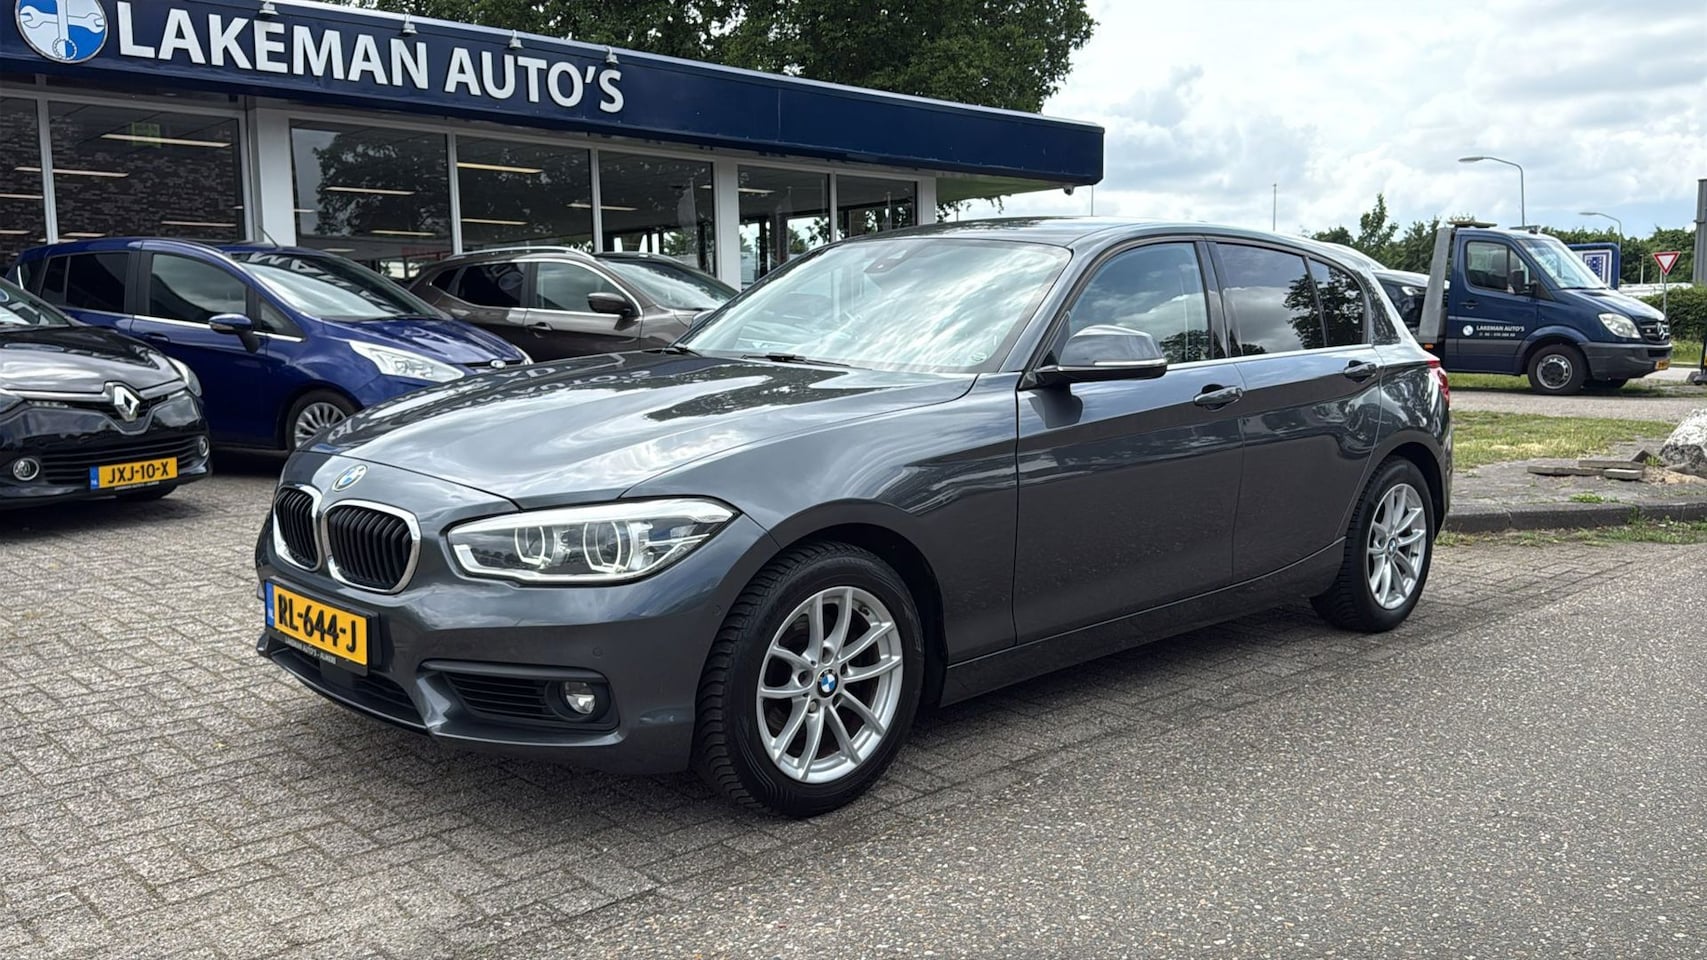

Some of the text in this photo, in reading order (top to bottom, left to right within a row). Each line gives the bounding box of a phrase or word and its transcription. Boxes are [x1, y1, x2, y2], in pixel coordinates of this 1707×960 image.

[117, 0, 625, 113] LAKEMAN AUTO'S
[108, 460, 169, 484] JXJ-10-X
[278, 594, 356, 652] RL-644-J
